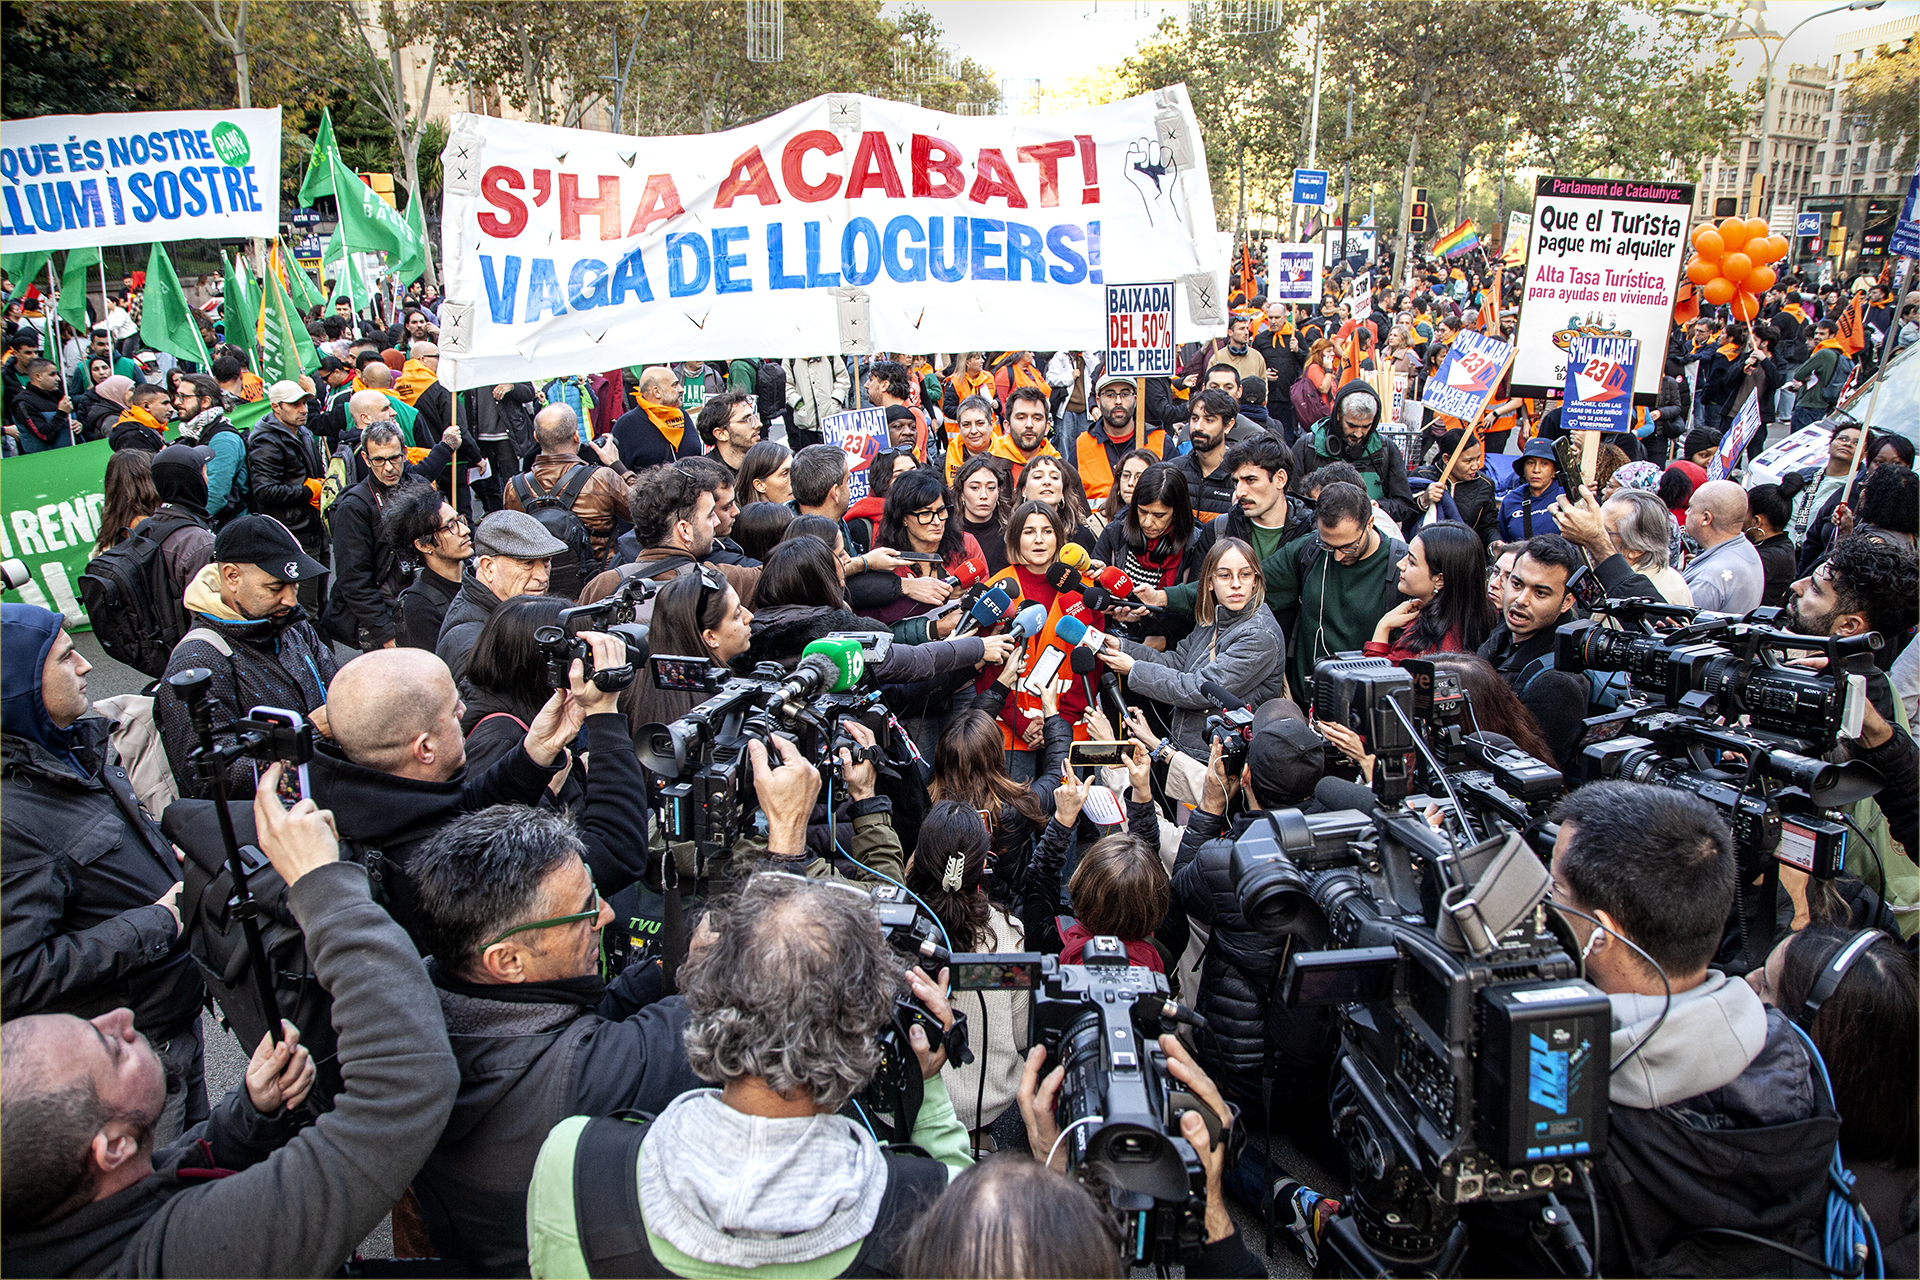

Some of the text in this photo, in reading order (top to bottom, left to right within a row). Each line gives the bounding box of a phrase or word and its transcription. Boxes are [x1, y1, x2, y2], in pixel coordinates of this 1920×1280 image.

[1, 128, 216, 186] QUE ÉS NOSTRE
[107, 176, 127, 226] I
[128, 165, 262, 224] SOSTRE
[477, 129, 1100, 241] S'HA ACABAT!
[1302, 192, 1318, 200] taxi
[1553, 179, 1682, 203] Parlament de Catalunya:
[294, 214, 308, 222] ATM
[1540, 205, 1681, 238] Que el Turista
[1332, 236, 1359, 248] BLCK
[1538, 235, 1585, 258] pague
[1590, 237, 1612, 255] mi
[1616, 238, 1675, 260] alquiler
[479, 215, 1104, 325] VAGA DE LLOGUERS!
[1536, 265, 1666, 292] Alta Tasa Turística,
[1109, 287, 1171, 313] BAIXADA
[1528, 286, 1669, 306] para ayudas en vivienda
[1110, 312, 1171, 349] DEL 50%
[1111, 349, 1171, 371] DEL PREU
[1595, 338, 1637, 366] ACABAT
[1428, 380, 1471, 401] ABAIXEM
[1429, 392, 1478, 418] LLOGUERS
[846, 408, 886, 437] ACABAT
[983, 596, 1003, 617] EFE:
[1803, 688, 1822, 696] SONY
[1438, 701, 1457, 711] 920
[629, 916, 662, 935] TVU
[1077, 1124, 1087, 1152] SONY
